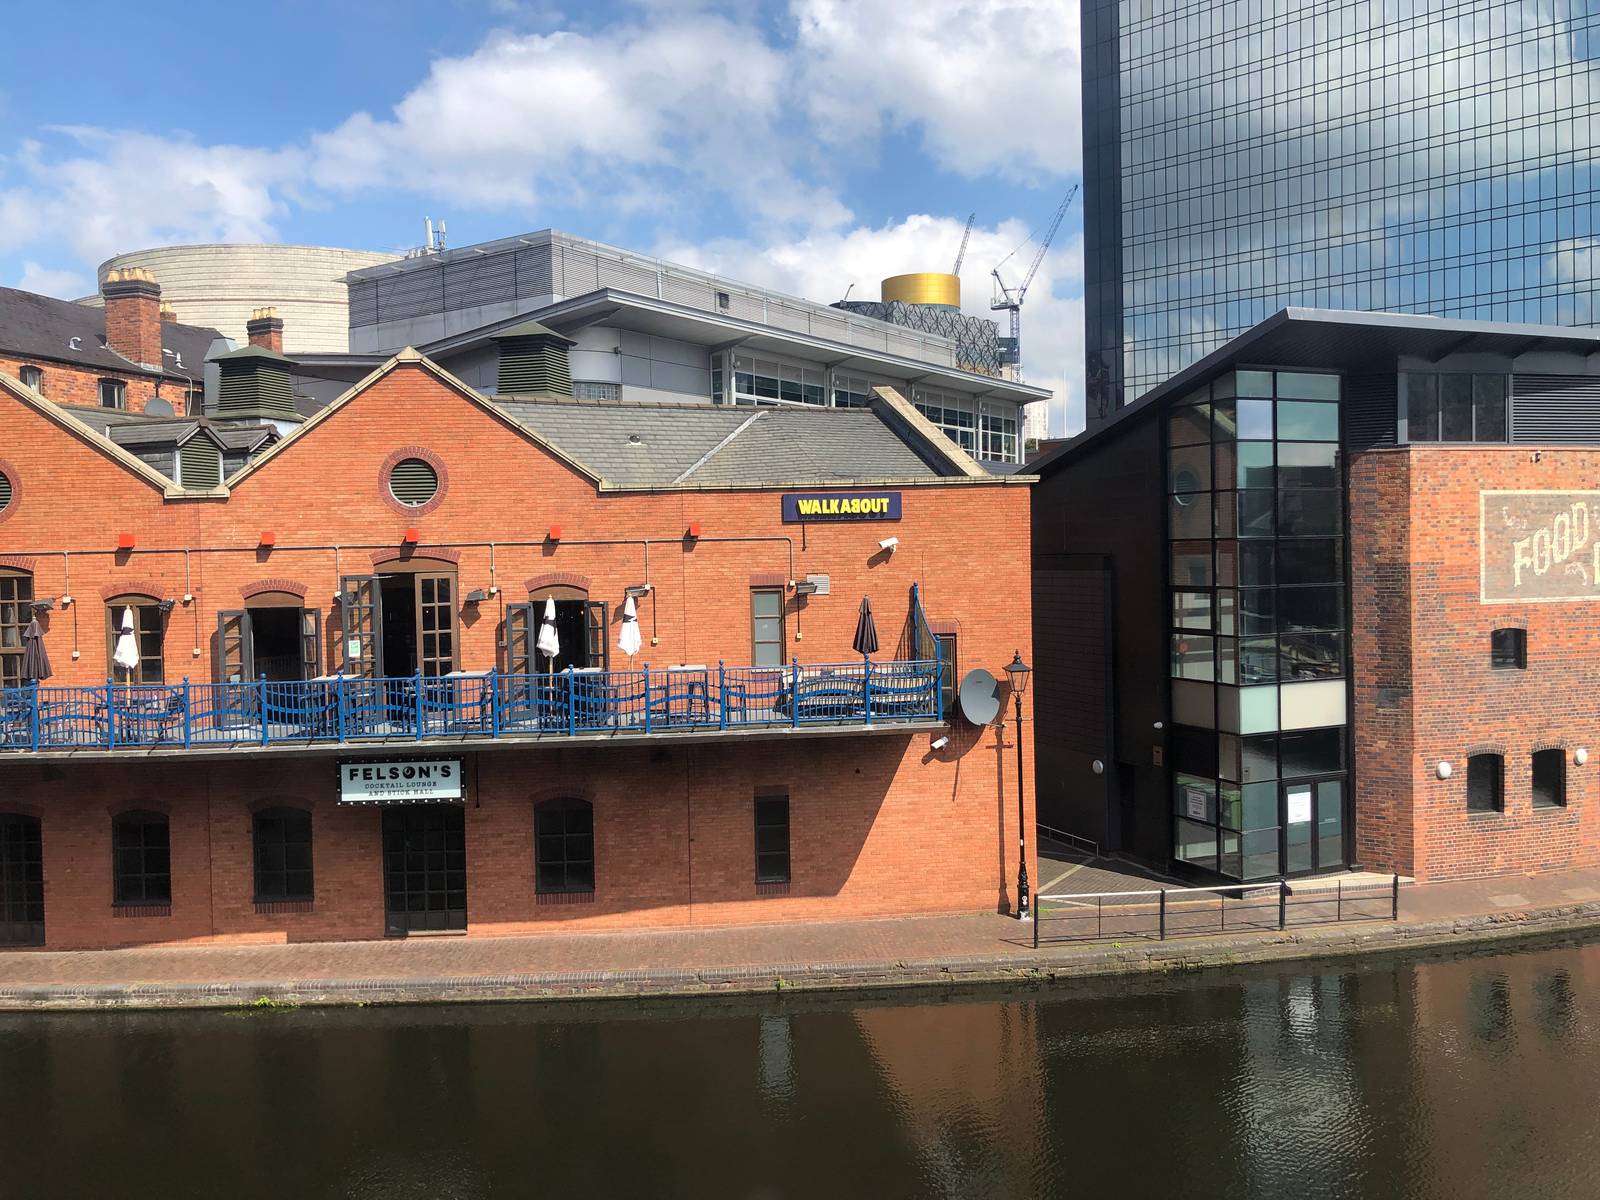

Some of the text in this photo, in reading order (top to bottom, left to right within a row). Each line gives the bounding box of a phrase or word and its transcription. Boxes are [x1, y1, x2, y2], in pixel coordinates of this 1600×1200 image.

[797, 497, 890, 515] WALKABOUT
[1512, 501, 1589, 588] FOOD
[349, 764, 452, 781] FELSON'S
[364, 782, 404, 790] COCKTAIL
